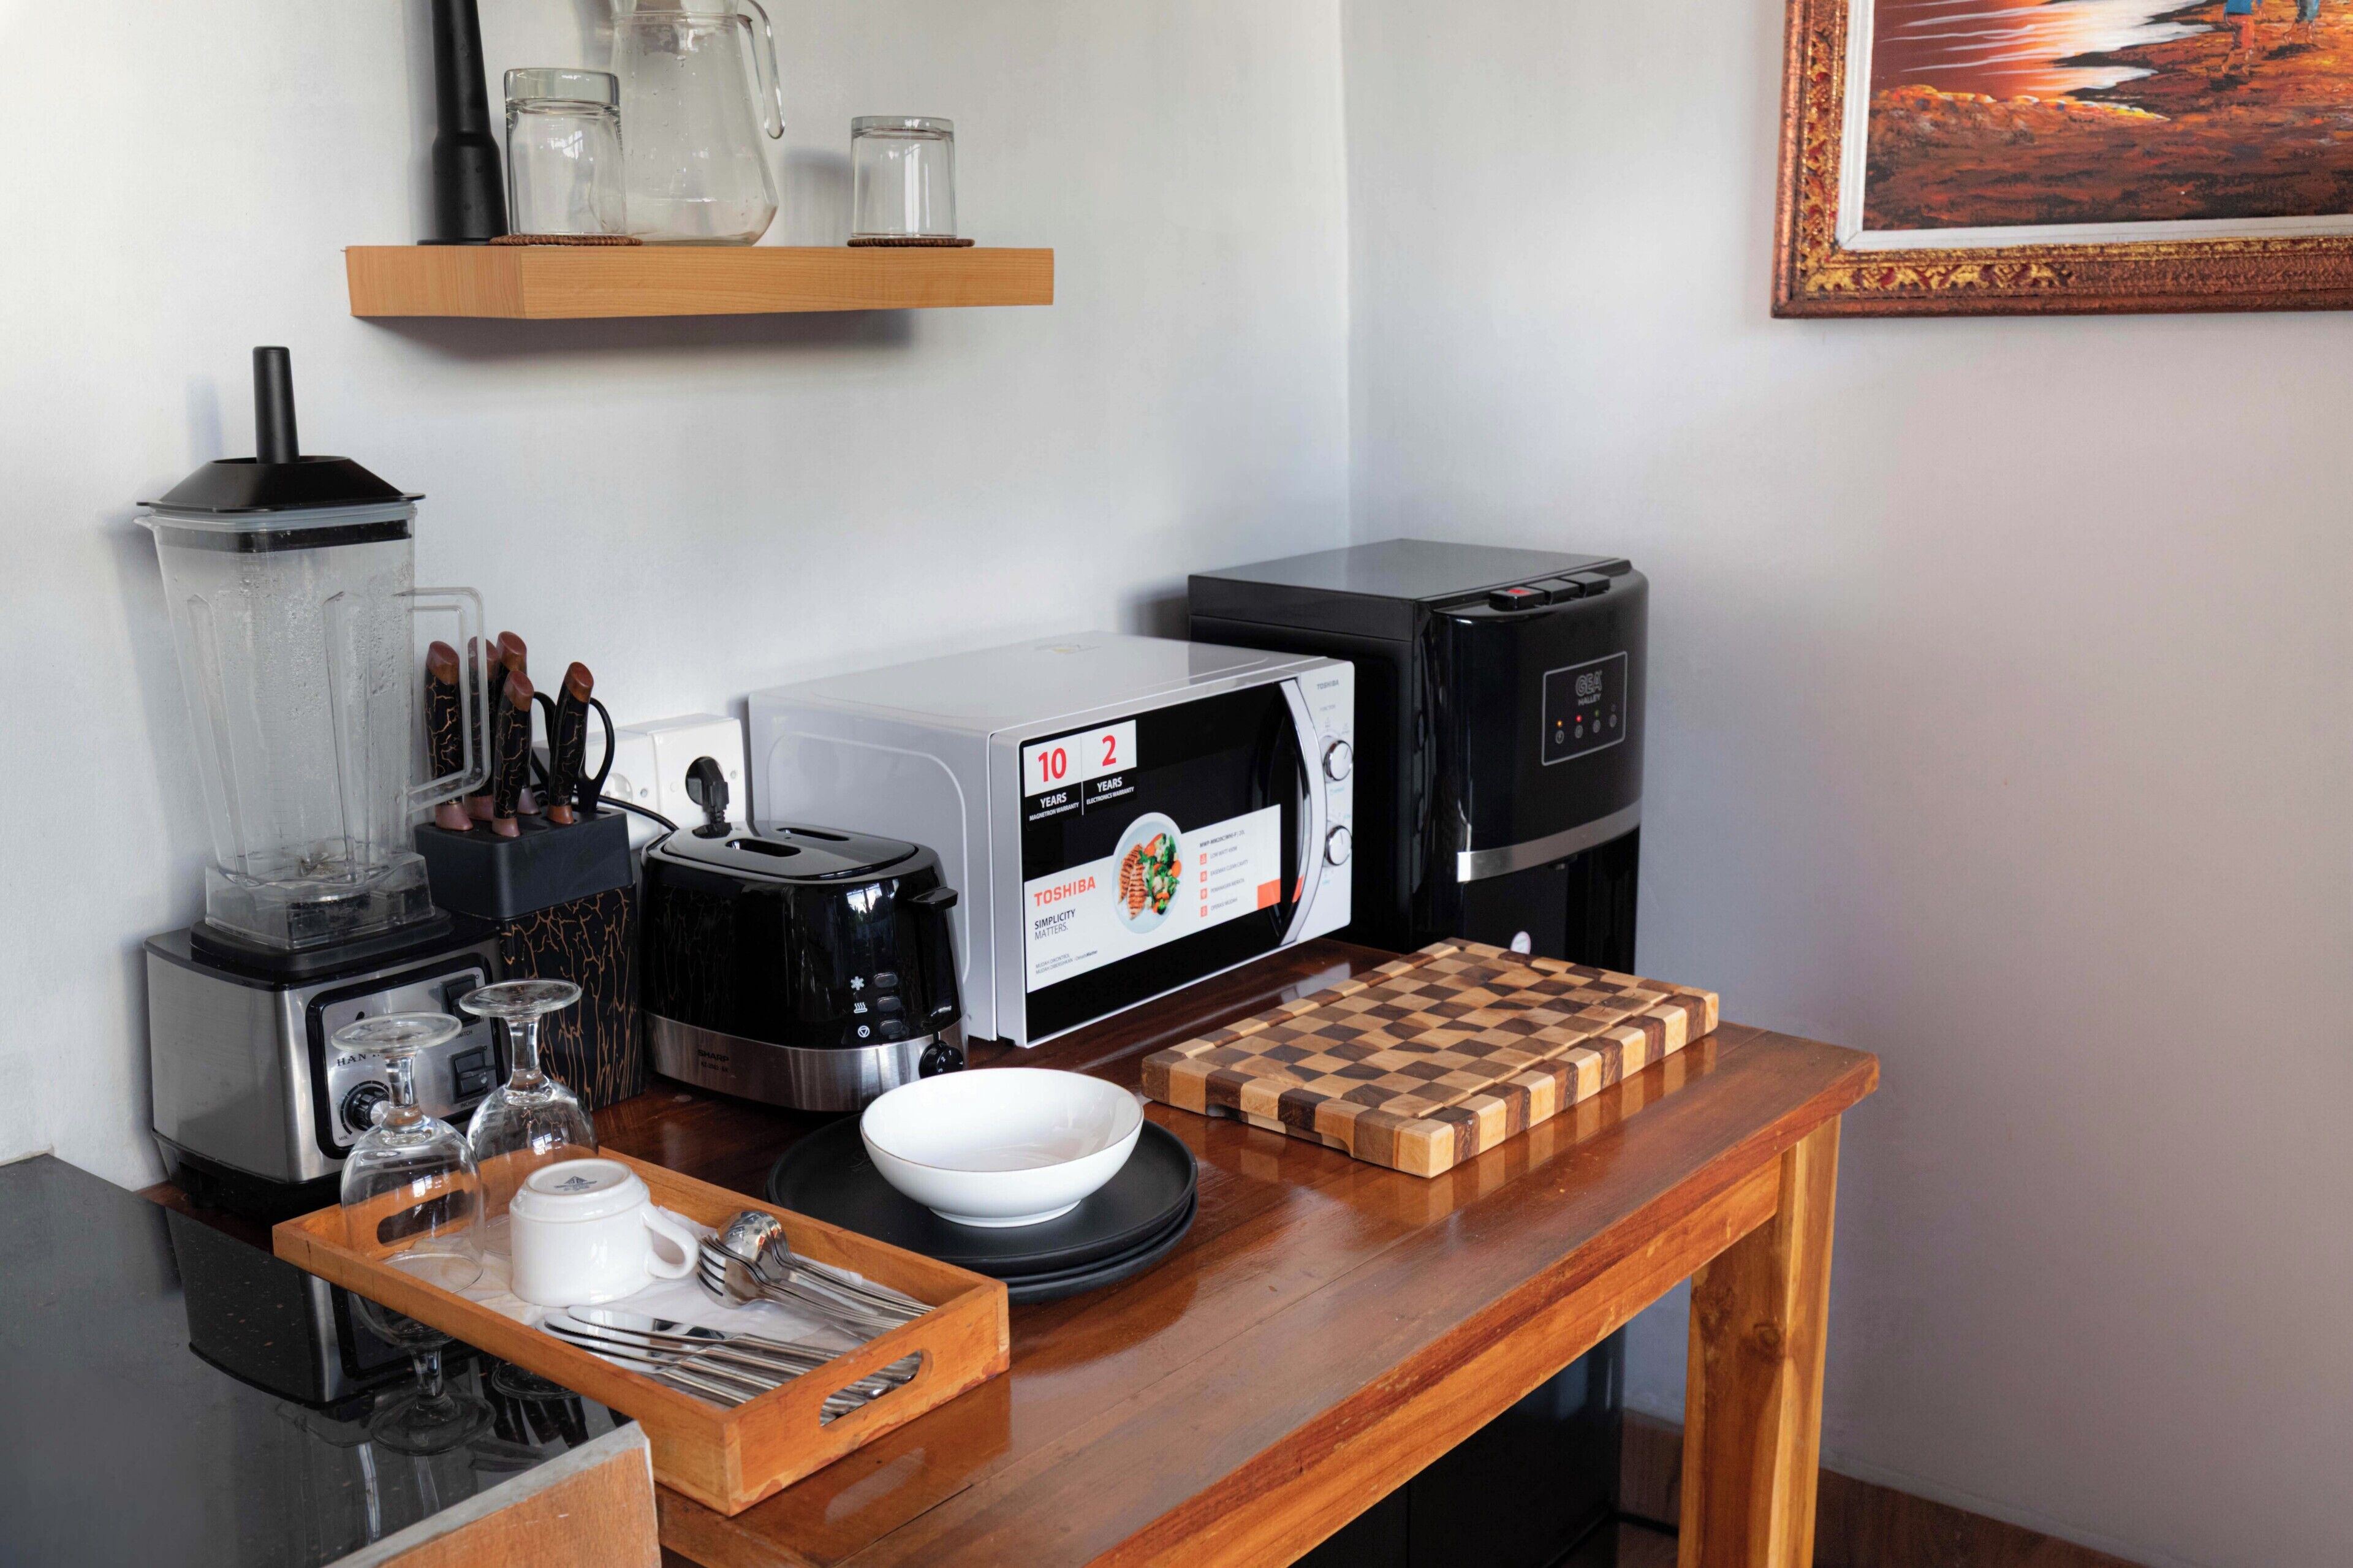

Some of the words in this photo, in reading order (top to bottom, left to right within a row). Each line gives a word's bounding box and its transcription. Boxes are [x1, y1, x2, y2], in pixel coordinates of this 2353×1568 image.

[1317, 679, 1339, 690] TOSHIBA
[1575, 671, 1602, 697] GEA
[1102, 735, 1116, 767] 2
[1038, 748, 1067, 782] 10
[1097, 776, 1123, 793] YEARS
[1040, 792, 1067, 809] YEARS
[1086, 793, 1113, 805] ELECTRONICS
[1113, 786, 1135, 798] WARRANTY
[1029, 806, 1056, 822] MAGNETRON
[1056, 801, 1080, 814] WARRANTY
[1034, 876, 1096, 907] TOSHIBA
[1034, 909, 1076, 930] SIMPLICITY
[1034, 922, 1069, 941] MATTERS.
[698, 1049, 729, 1061] SHARP
